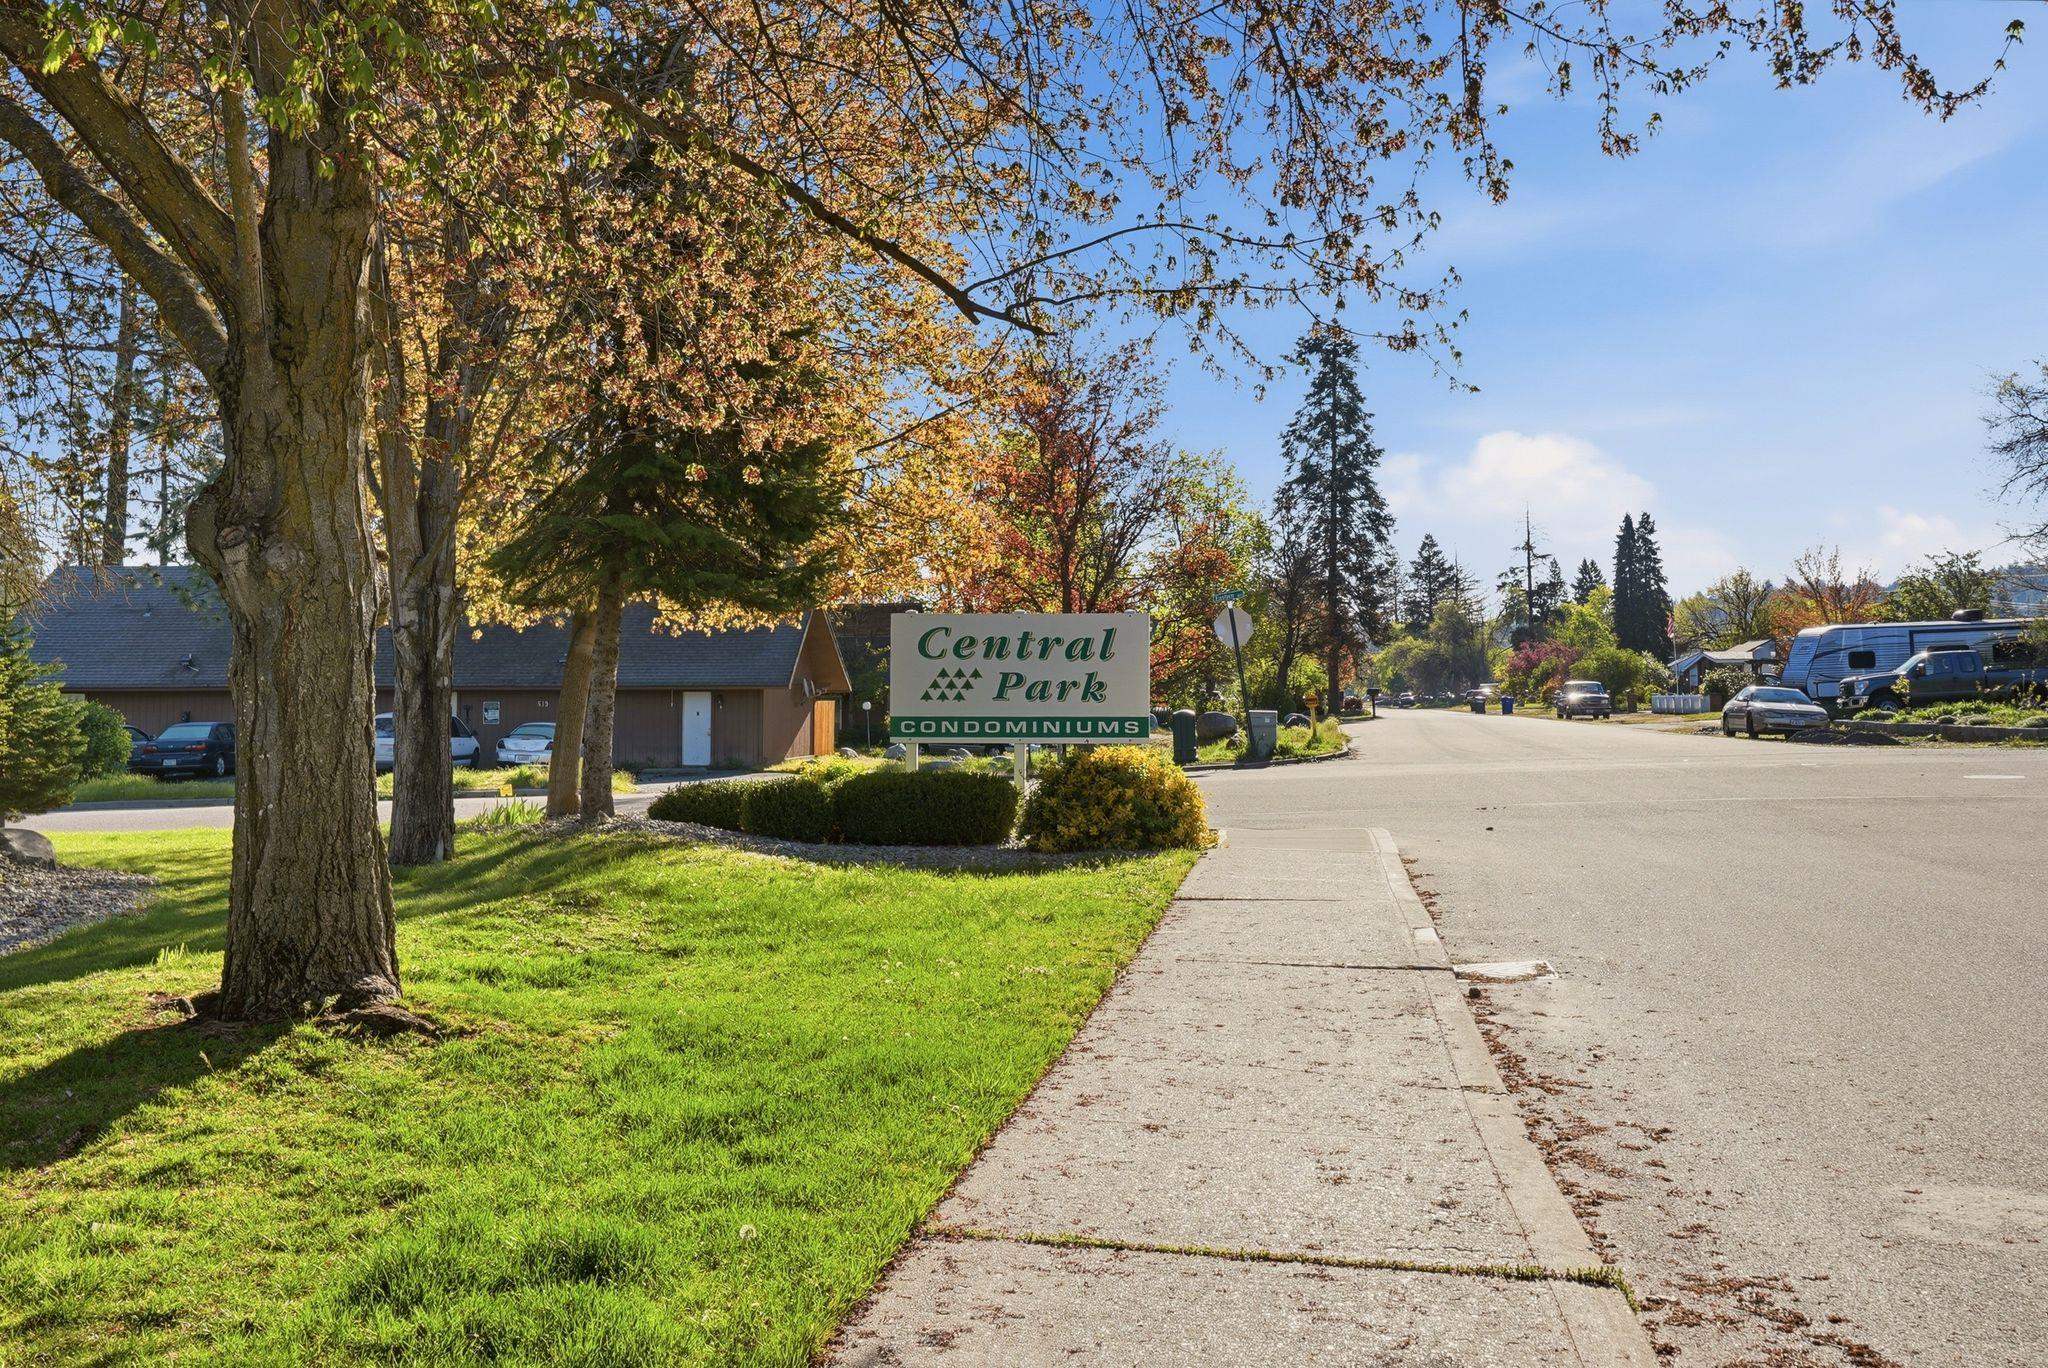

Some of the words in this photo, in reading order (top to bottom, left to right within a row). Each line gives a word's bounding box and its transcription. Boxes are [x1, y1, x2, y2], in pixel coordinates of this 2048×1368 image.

[917, 626, 1117, 662] Central
[992, 671, 1108, 702] Park
[900, 720, 1140, 734] CONDOMINIUMS
